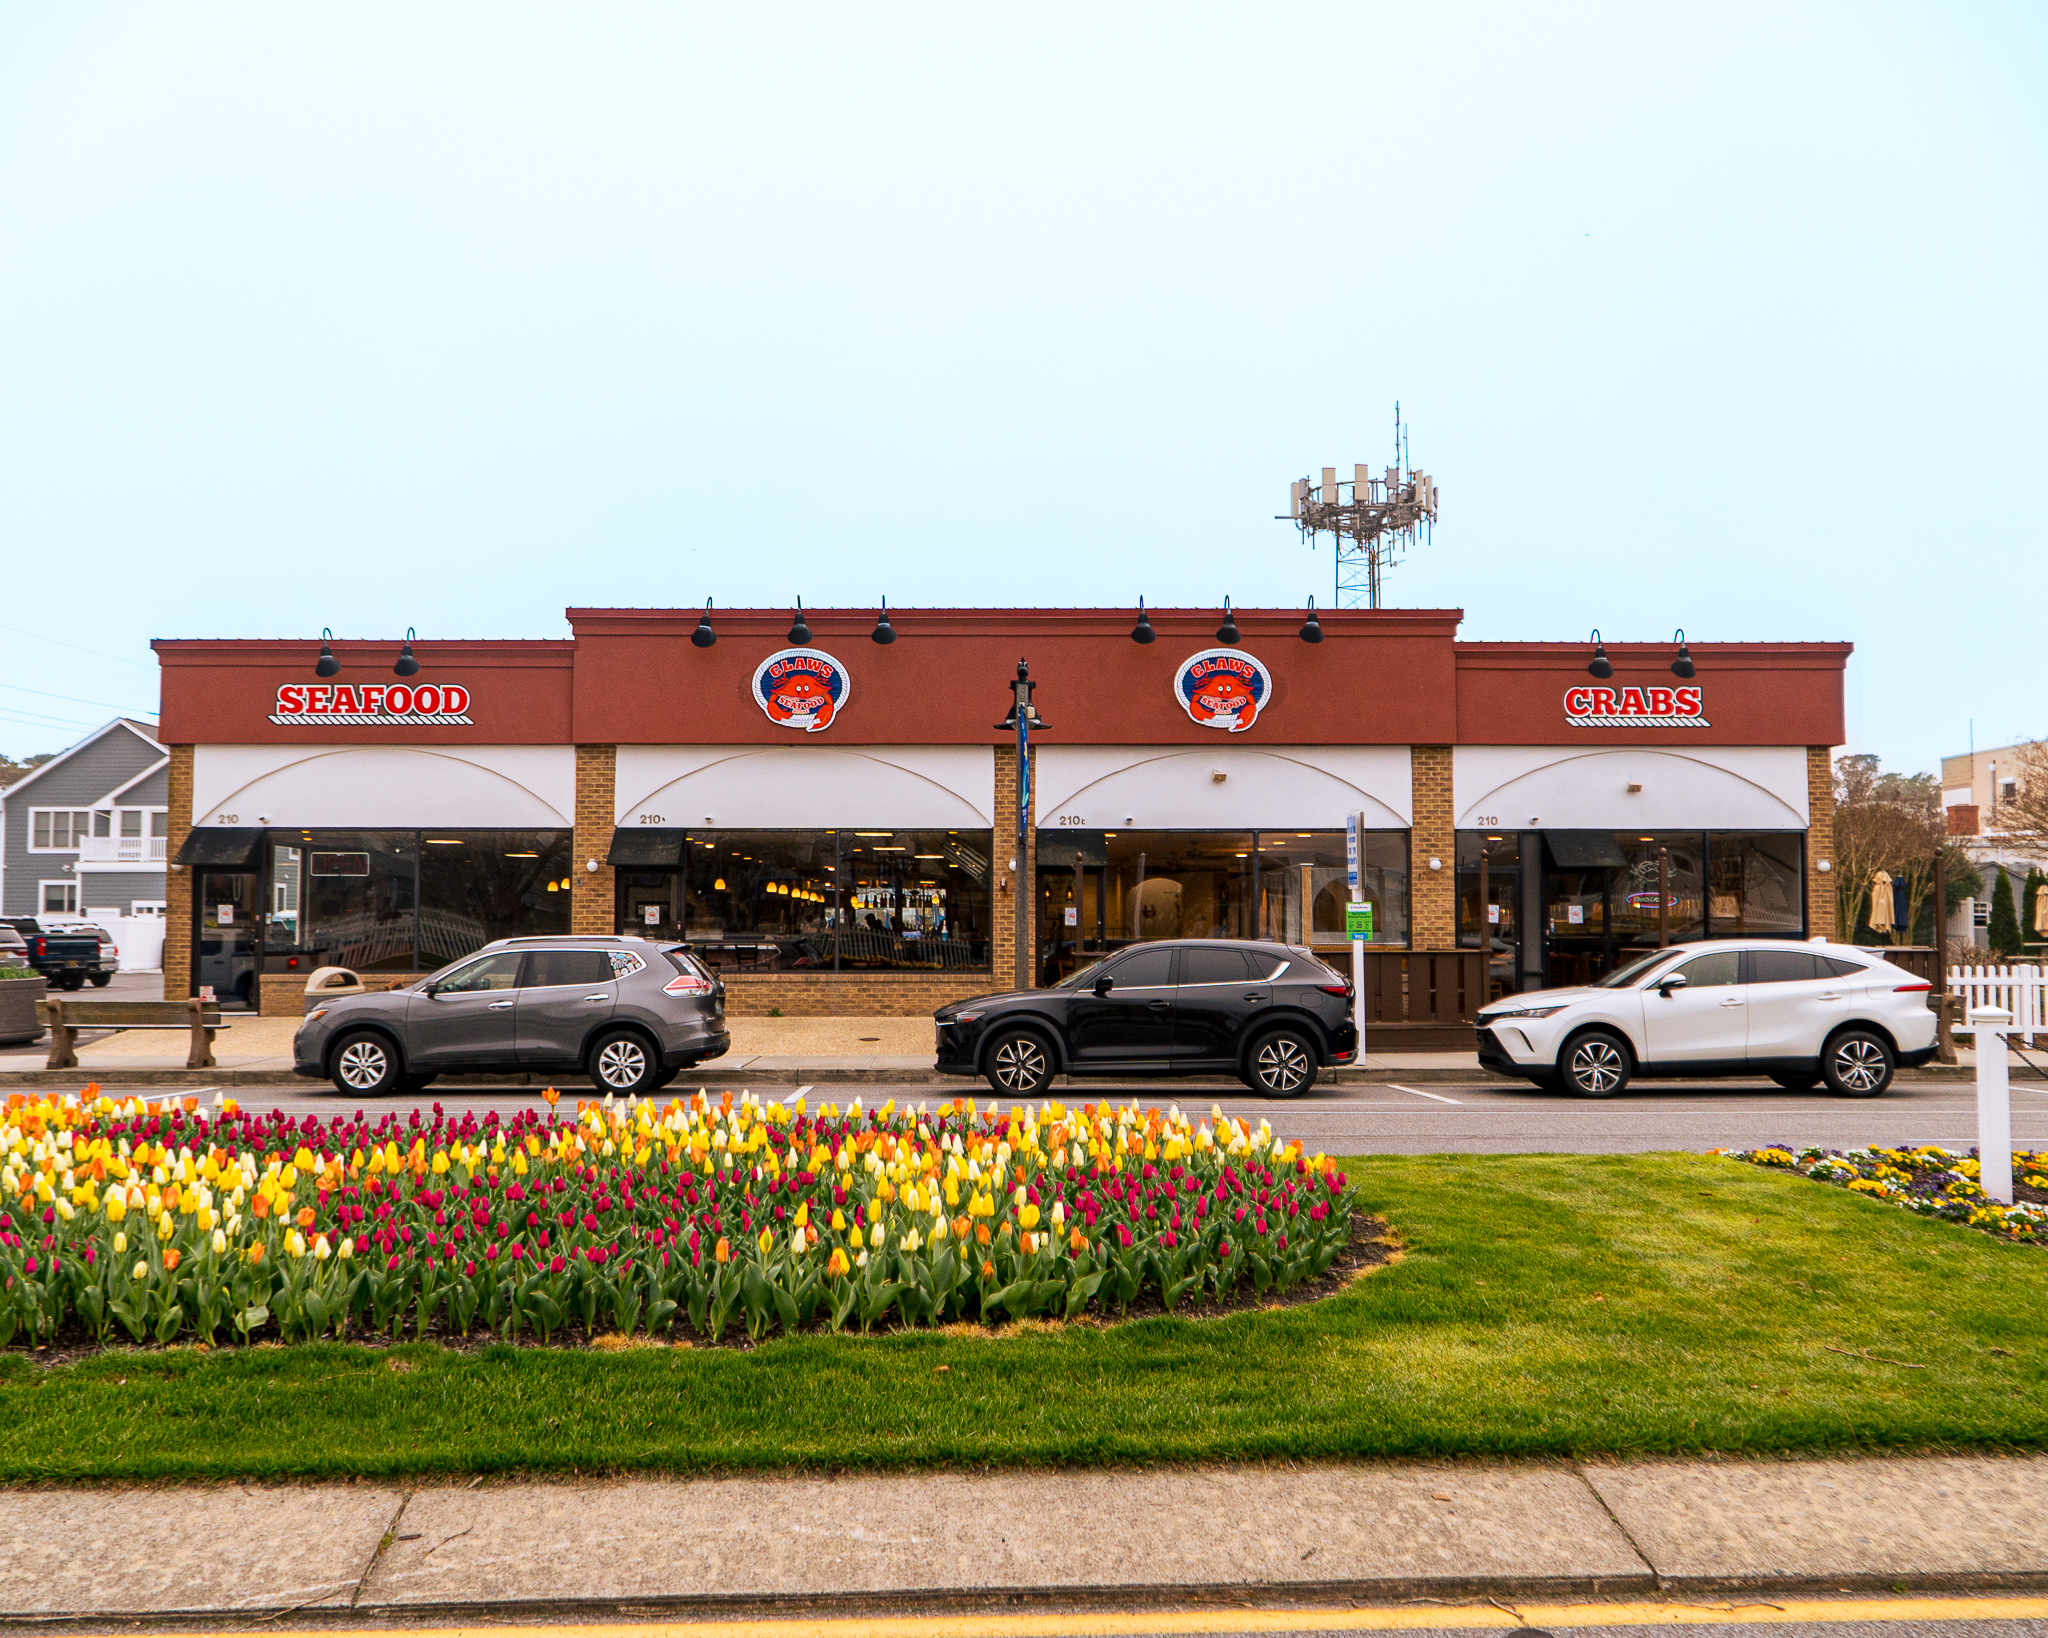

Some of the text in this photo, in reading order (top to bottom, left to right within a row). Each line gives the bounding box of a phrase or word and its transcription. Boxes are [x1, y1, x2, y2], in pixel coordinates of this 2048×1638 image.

[769, 658, 834, 678] CLAWS
[1191, 658, 1255, 678] CLAWS
[276, 683, 471, 716] SEAFOOD
[778, 696, 824, 710] SEAFOOD
[1200, 696, 1247, 710] SEAFOOD
[1564, 686, 1703, 717] CRABS
[219, 814, 239, 824] 210
[1478, 816, 1498, 826] 210
[312, 855, 367, 873] OPEN
